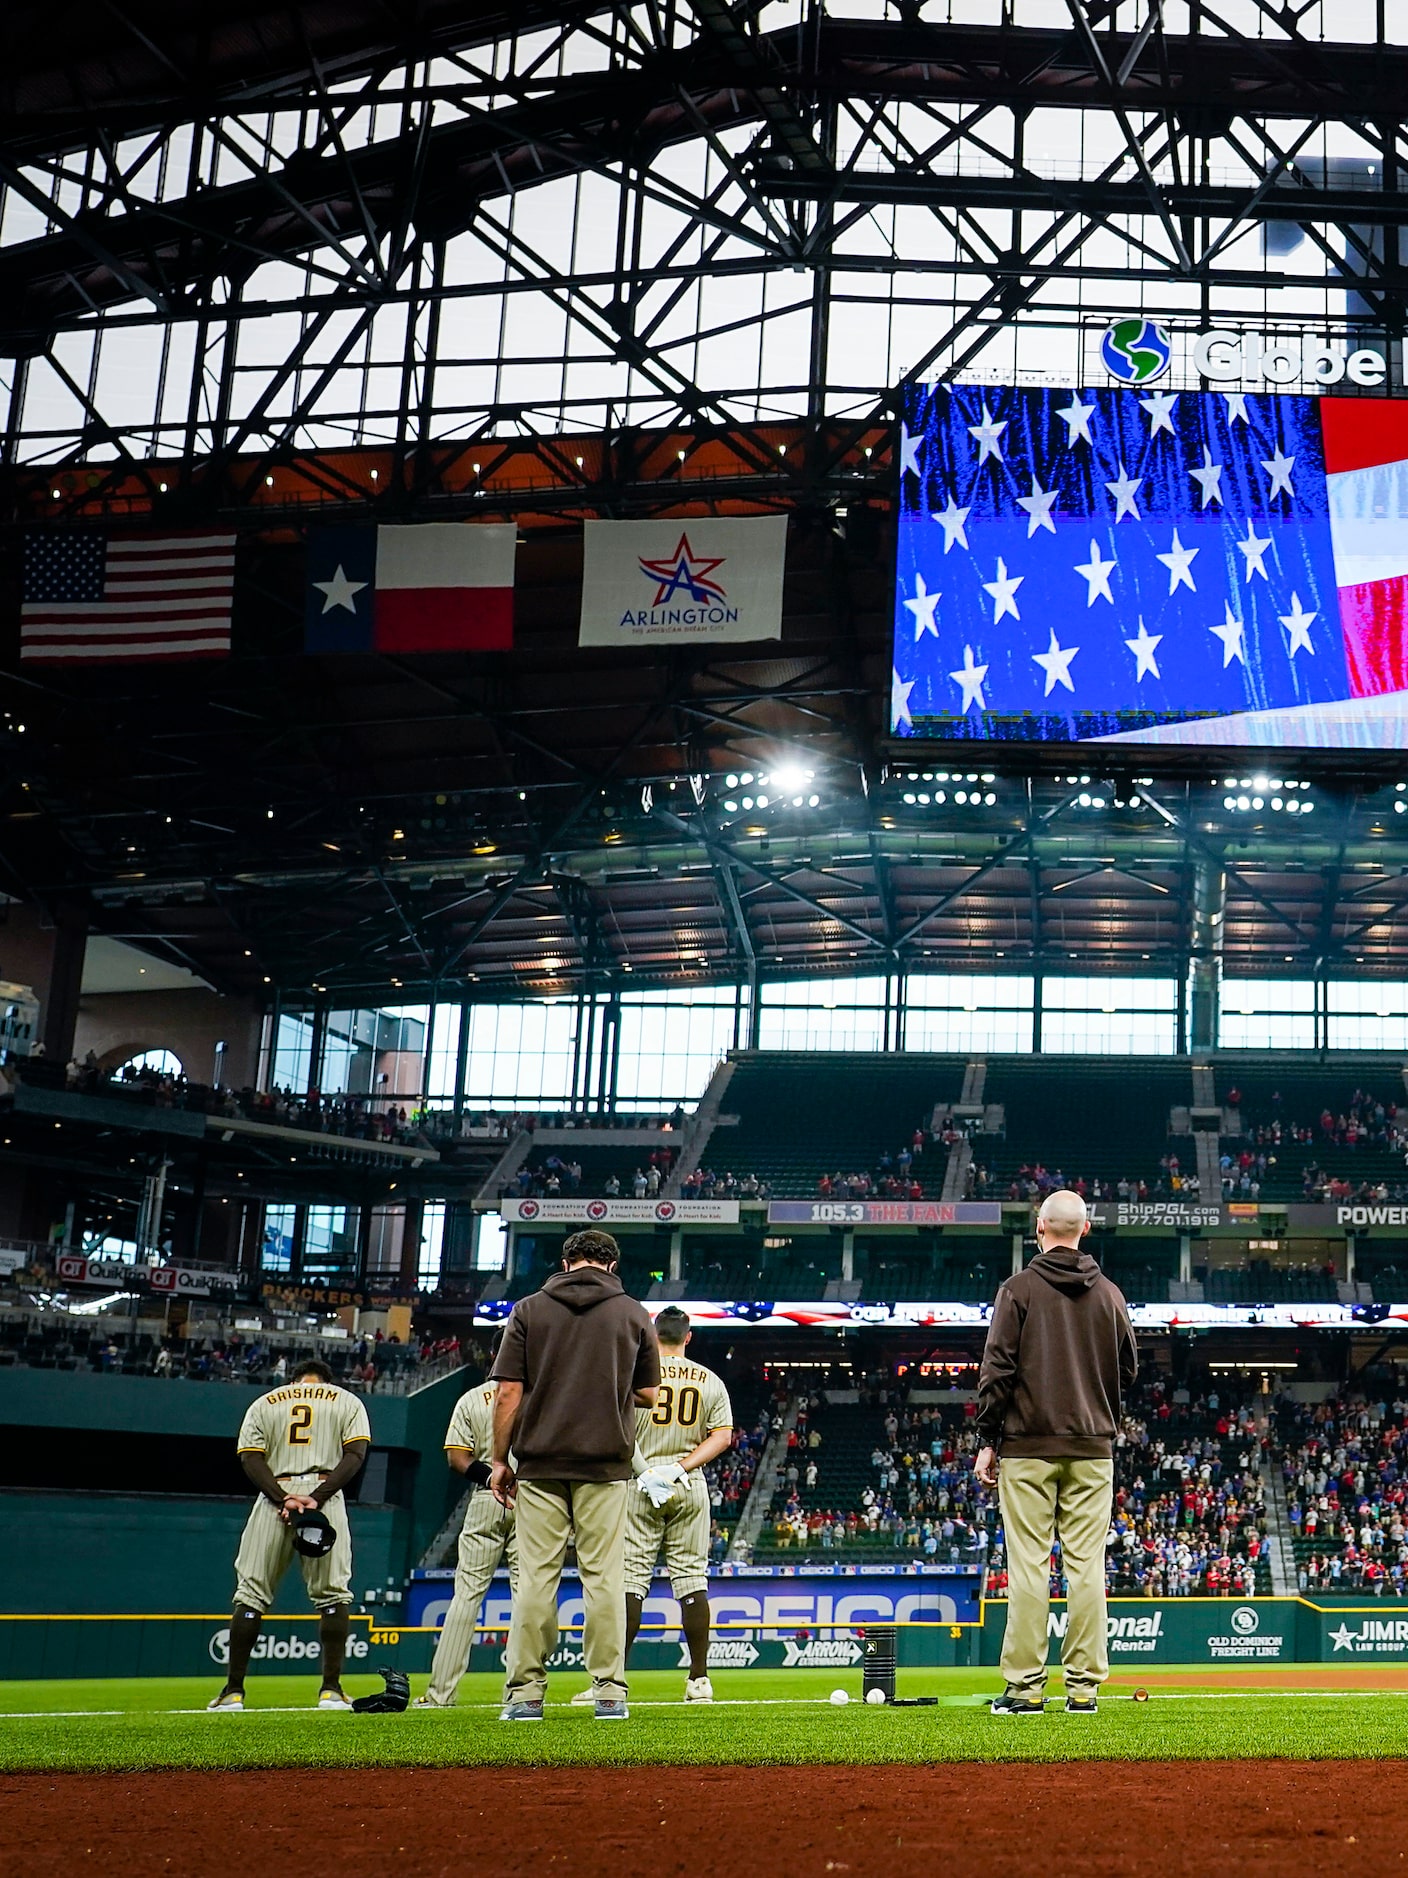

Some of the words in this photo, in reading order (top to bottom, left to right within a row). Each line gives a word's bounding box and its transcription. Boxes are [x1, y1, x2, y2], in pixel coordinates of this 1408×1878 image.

[1193, 330, 1387, 387] Globe
[619, 607, 739, 627] ARLINGTON
[646, 626, 682, 634] AMERICAN
[684, 625, 708, 633] DREAM
[811, 1205, 864, 1221] 105.3
[868, 1205, 908, 1221] THE
[912, 1205, 956, 1222] FAN
[1117, 1203, 1220, 1215] ShipPGL.com
[1117, 1215, 1220, 1226] 877.701.1919
[60, 1261, 83, 1277] QT
[151, 1270, 174, 1286] QT
[660, 1366, 708, 1385] OSMER
[266, 1387, 339, 1406] GRISHAM
[652, 1384, 702, 1429] 30
[287, 1402, 315, 1447] 2
[738, 1567, 773, 1576] GEICO
[799, 1566, 835, 1575] GEICO
[860, 1566, 895, 1575] GEICO
[921, 1565, 956, 1574] GEICO
[709, 1594, 957, 1642] GEICO
[1047, 1611, 1164, 1638] Nonal.
[369, 1631, 400, 1645] 410
[1111, 1639, 1157, 1652] Rental
[1207, 1636, 1228, 1647] OLD
[1230, 1636, 1283, 1647] DOMINION
[250, 1635, 321, 1659] Globe
[345, 1634, 369, 1658] fe
[707, 1642, 748, 1659] RROW
[802, 1641, 853, 1658] ARROW
[1210, 1647, 1254, 1657] FREIGHT
[1256, 1647, 1280, 1657] LINE
[1355, 1642, 1374, 1652] LAW
[1375, 1642, 1406, 1652] GROUP
